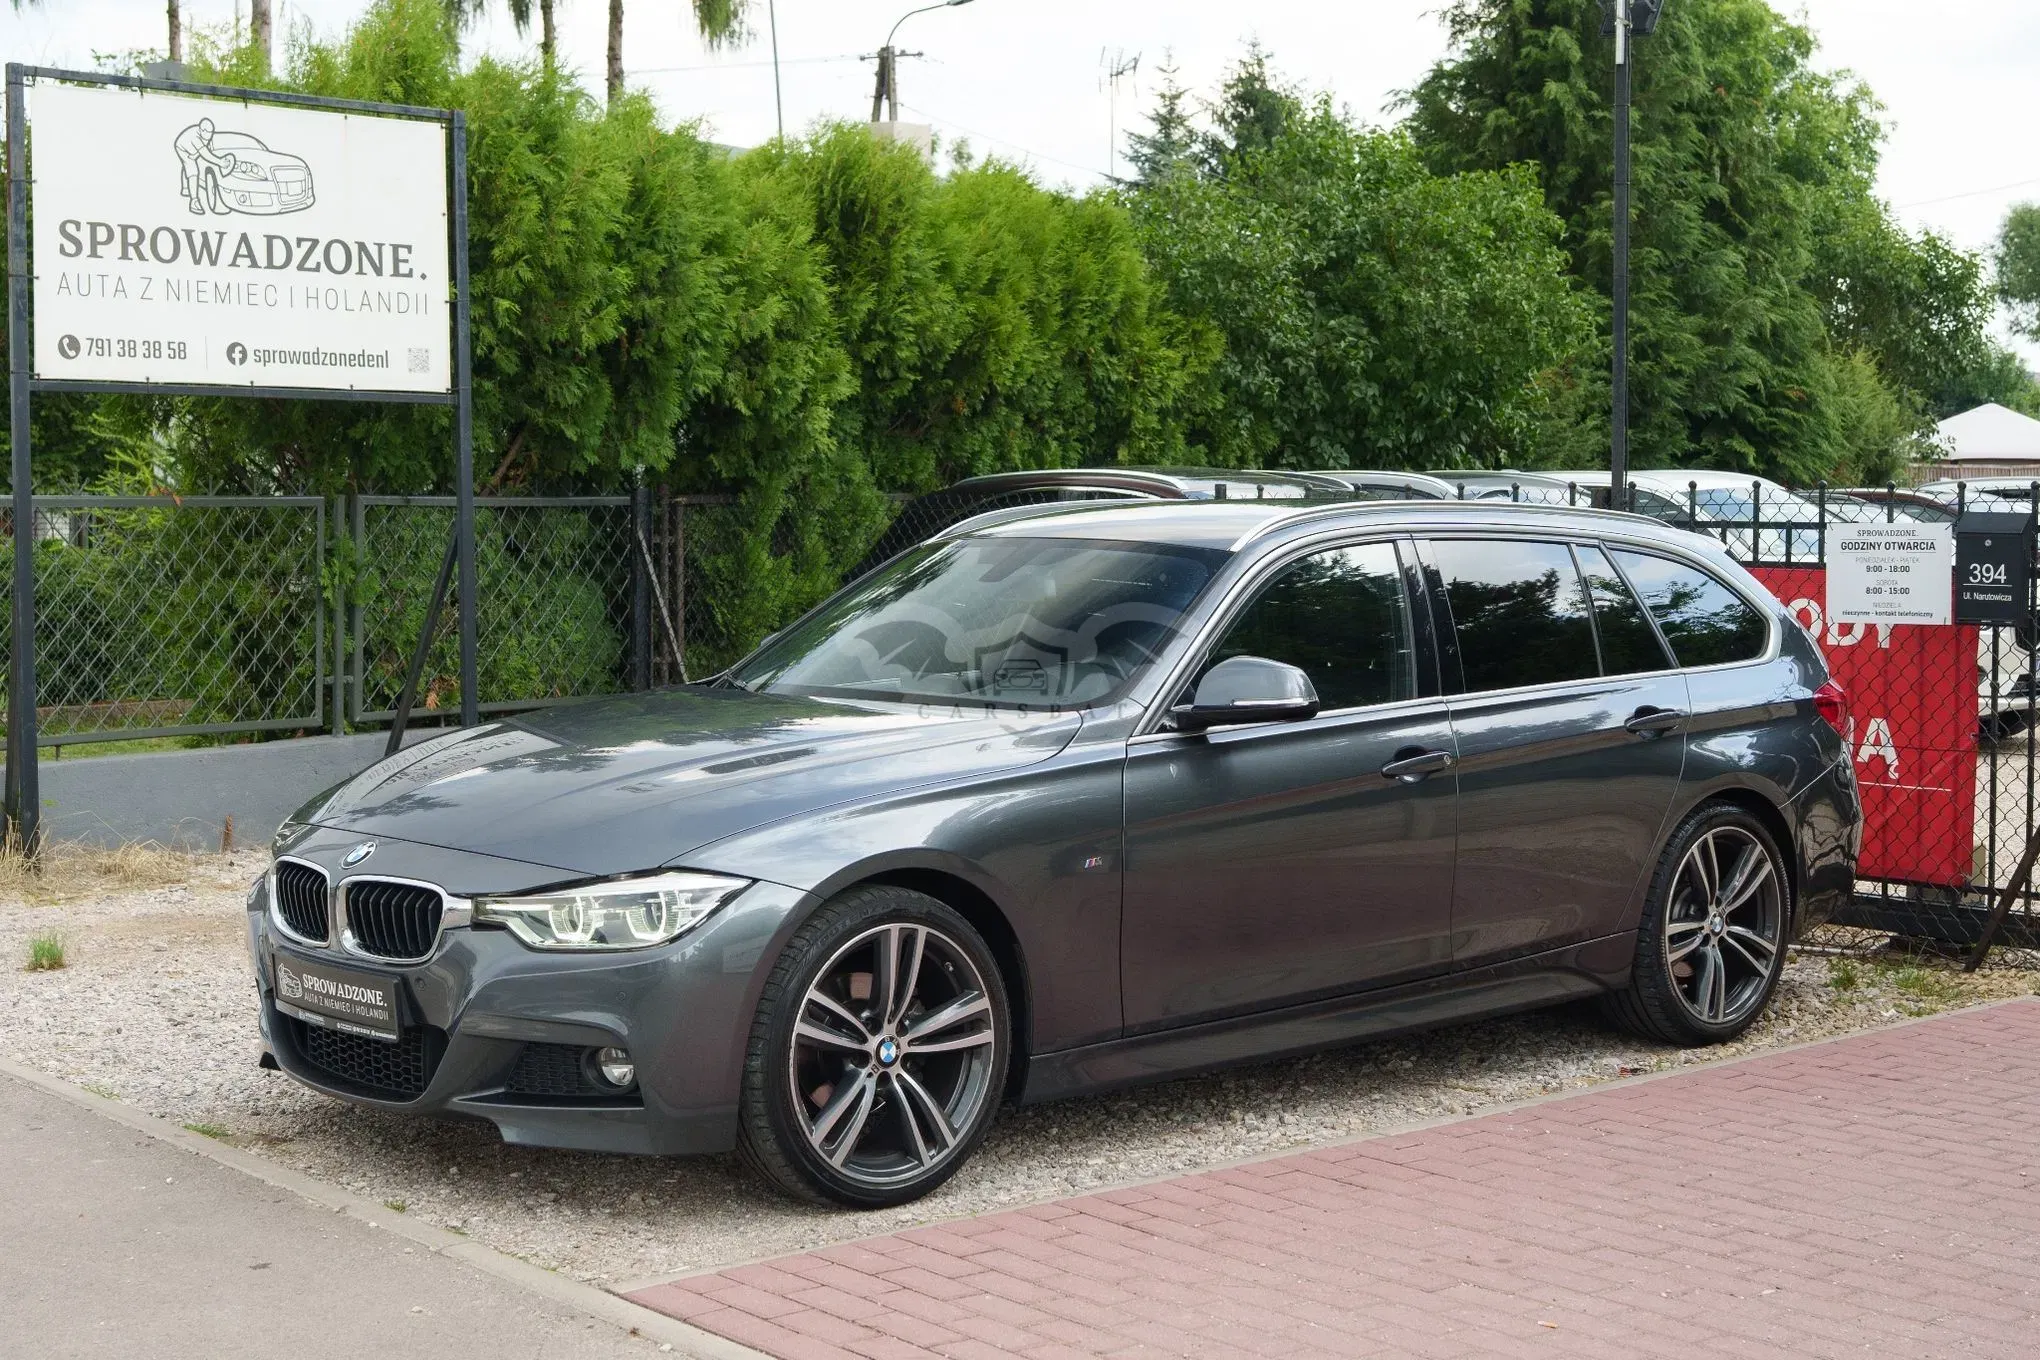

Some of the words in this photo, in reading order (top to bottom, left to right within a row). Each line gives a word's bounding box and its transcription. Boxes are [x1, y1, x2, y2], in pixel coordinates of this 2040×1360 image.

[58, 219, 428, 281] SPROWADZONE.
[57, 271, 128, 299] AUTA
[139, 276, 153, 301] Z
[166, 278, 278, 307] NIEMIEC
[305, 286, 429, 315] HOLANDII
[85, 337, 112, 358] 791
[116, 338, 138, 359] 38
[141, 340, 163, 360] 38
[167, 341, 187, 361] 58
[253, 346, 389, 369] sprowadzonedenl
[1840, 541, 1882, 551] GODZINY
[1884, 541, 1936, 551] OTWARCIA
[1866, 565, 1882, 573] 9:00
[1889, 565, 1910, 573] 18:00
[1969, 563, 2007, 584] 394
[1865, 587, 1882, 595] 8:00
[1889, 587, 1910, 595] 15:00
[1973, 592, 2012, 602] Narutowicza
[1898, 610, 1933, 618] telefoniczny
[302, 973, 388, 1007] SPROWADZONE.
[304, 992, 319, 1005] AUTA
[319, 995, 324, 1006] Z
[324, 997, 351, 1013] NIEMIEC
[355, 1004, 389, 1021] HOLANDII
